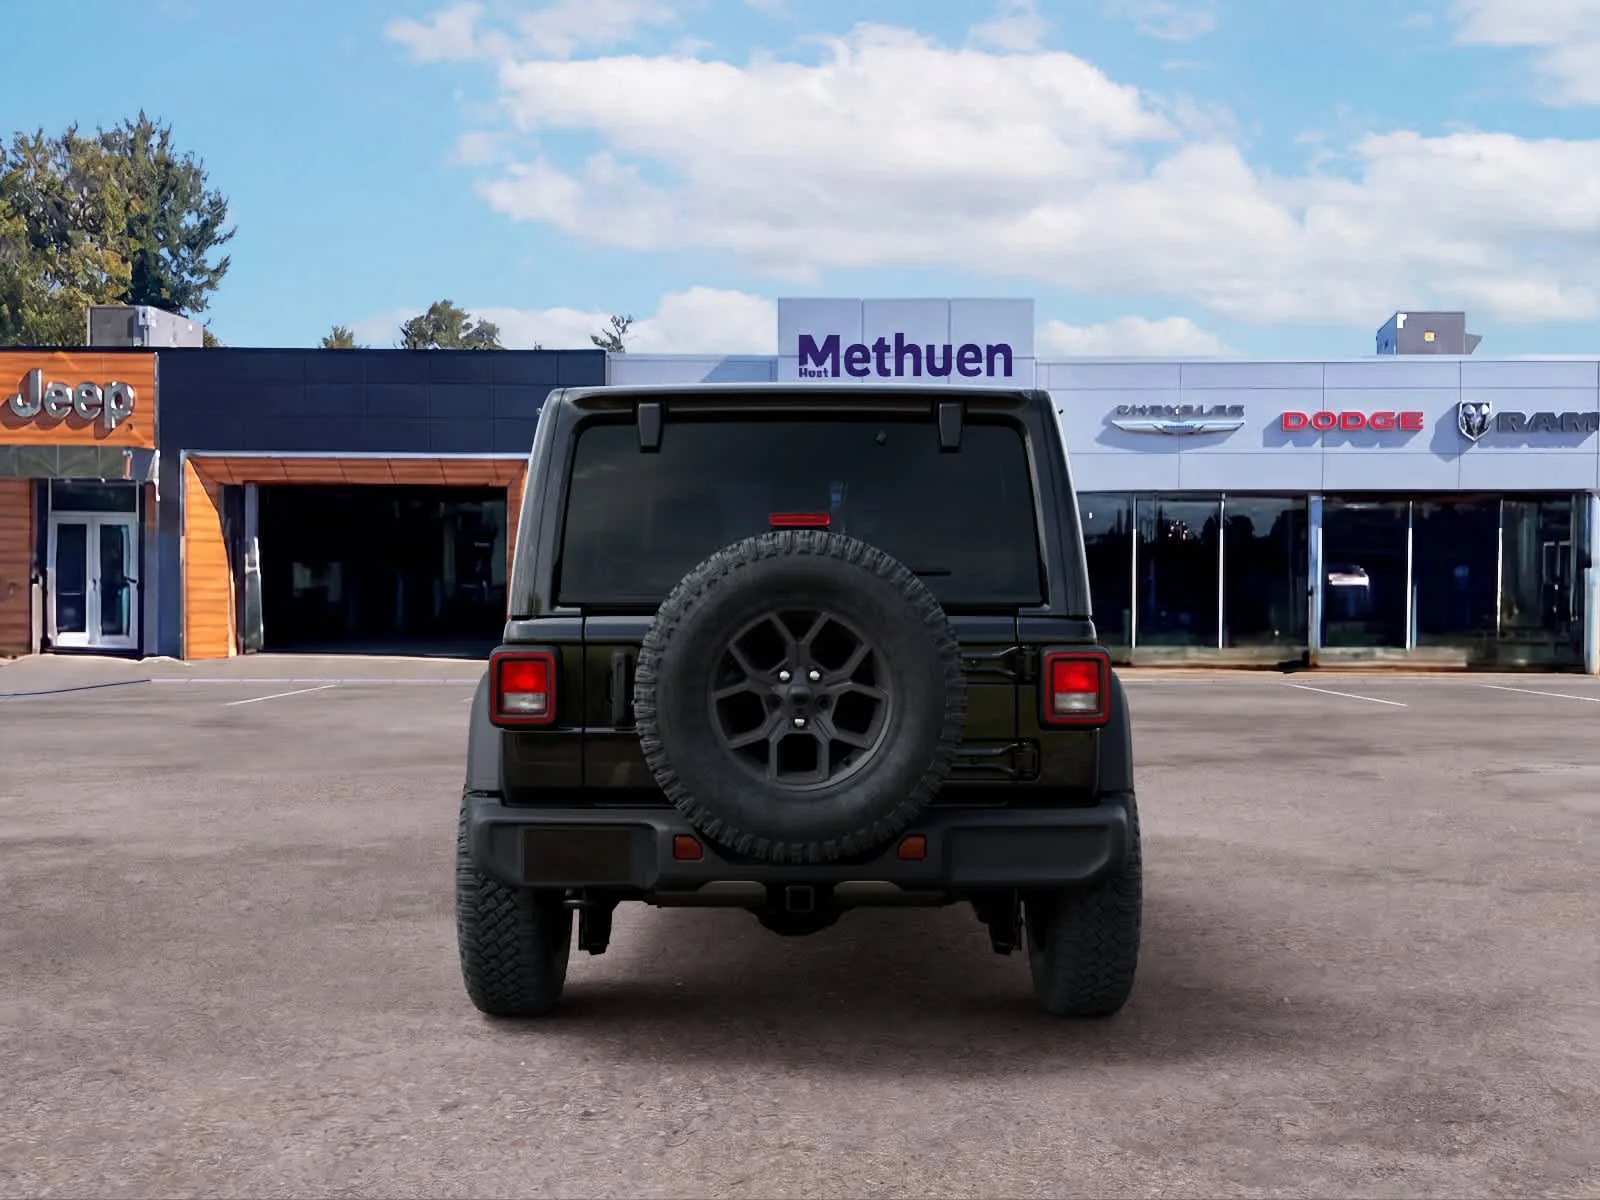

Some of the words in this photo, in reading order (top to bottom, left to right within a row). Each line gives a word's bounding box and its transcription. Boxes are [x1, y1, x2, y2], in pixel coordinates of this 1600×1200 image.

[799, 333, 1013, 378] Methuen
[9, 368, 135, 430] Jeep
[1282, 411, 1424, 431] DODGE
[1498, 411, 1600, 432] RAM
